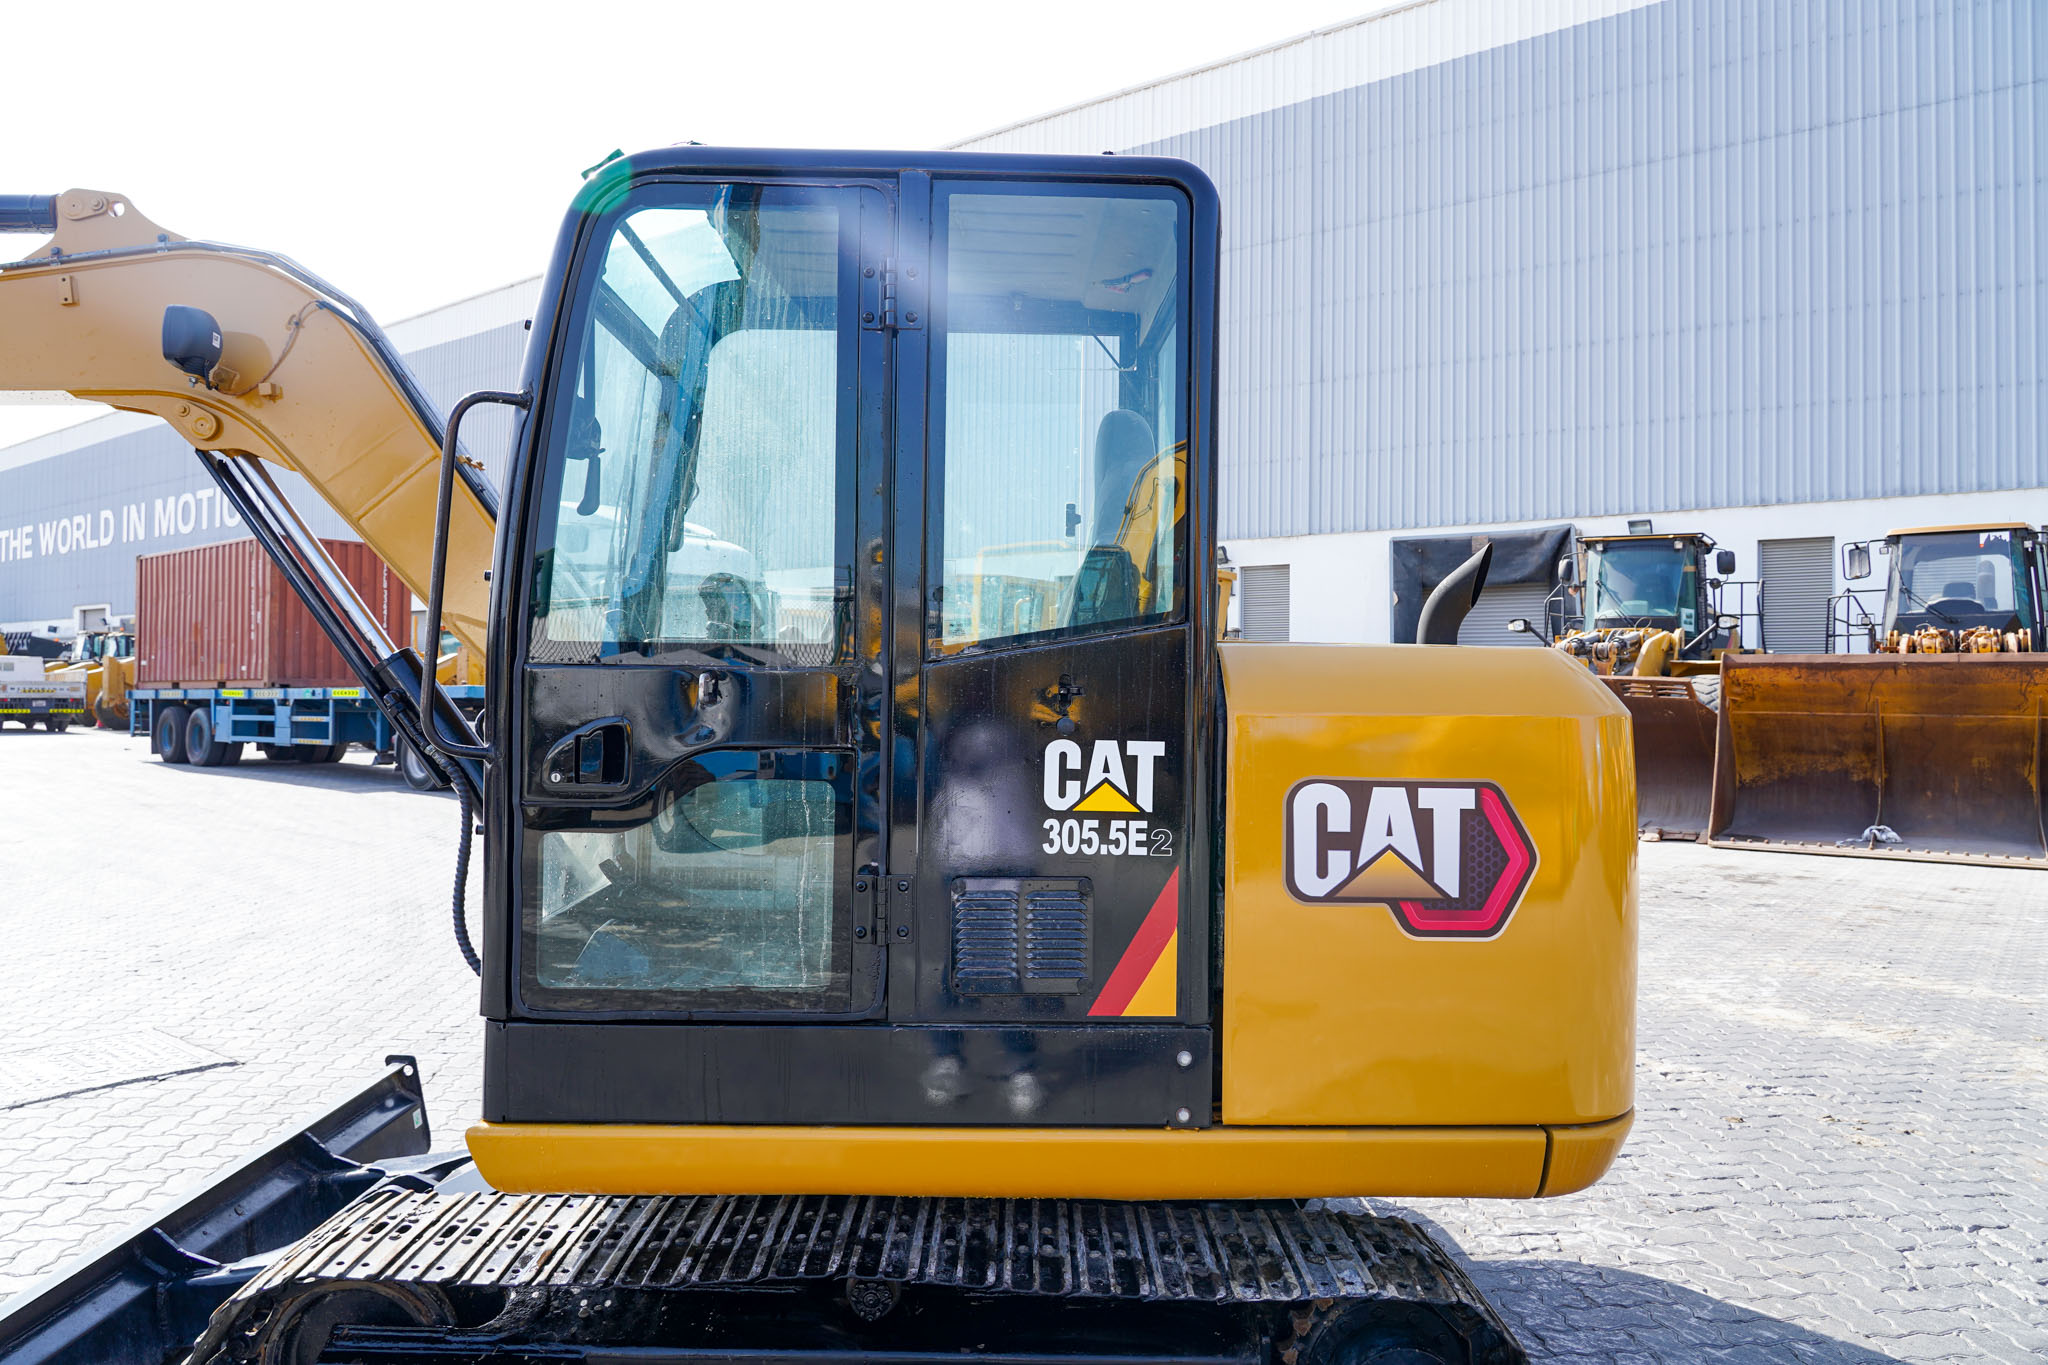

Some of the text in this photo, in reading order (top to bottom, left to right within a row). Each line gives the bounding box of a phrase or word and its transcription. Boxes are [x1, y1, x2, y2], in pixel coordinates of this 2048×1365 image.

[0, 525, 33, 563] THE
[38, 509, 115, 556] WORLD
[122, 502, 146, 543] IN
[1043, 738, 1166, 813] CAT
[1293, 782, 1476, 898] CAT
